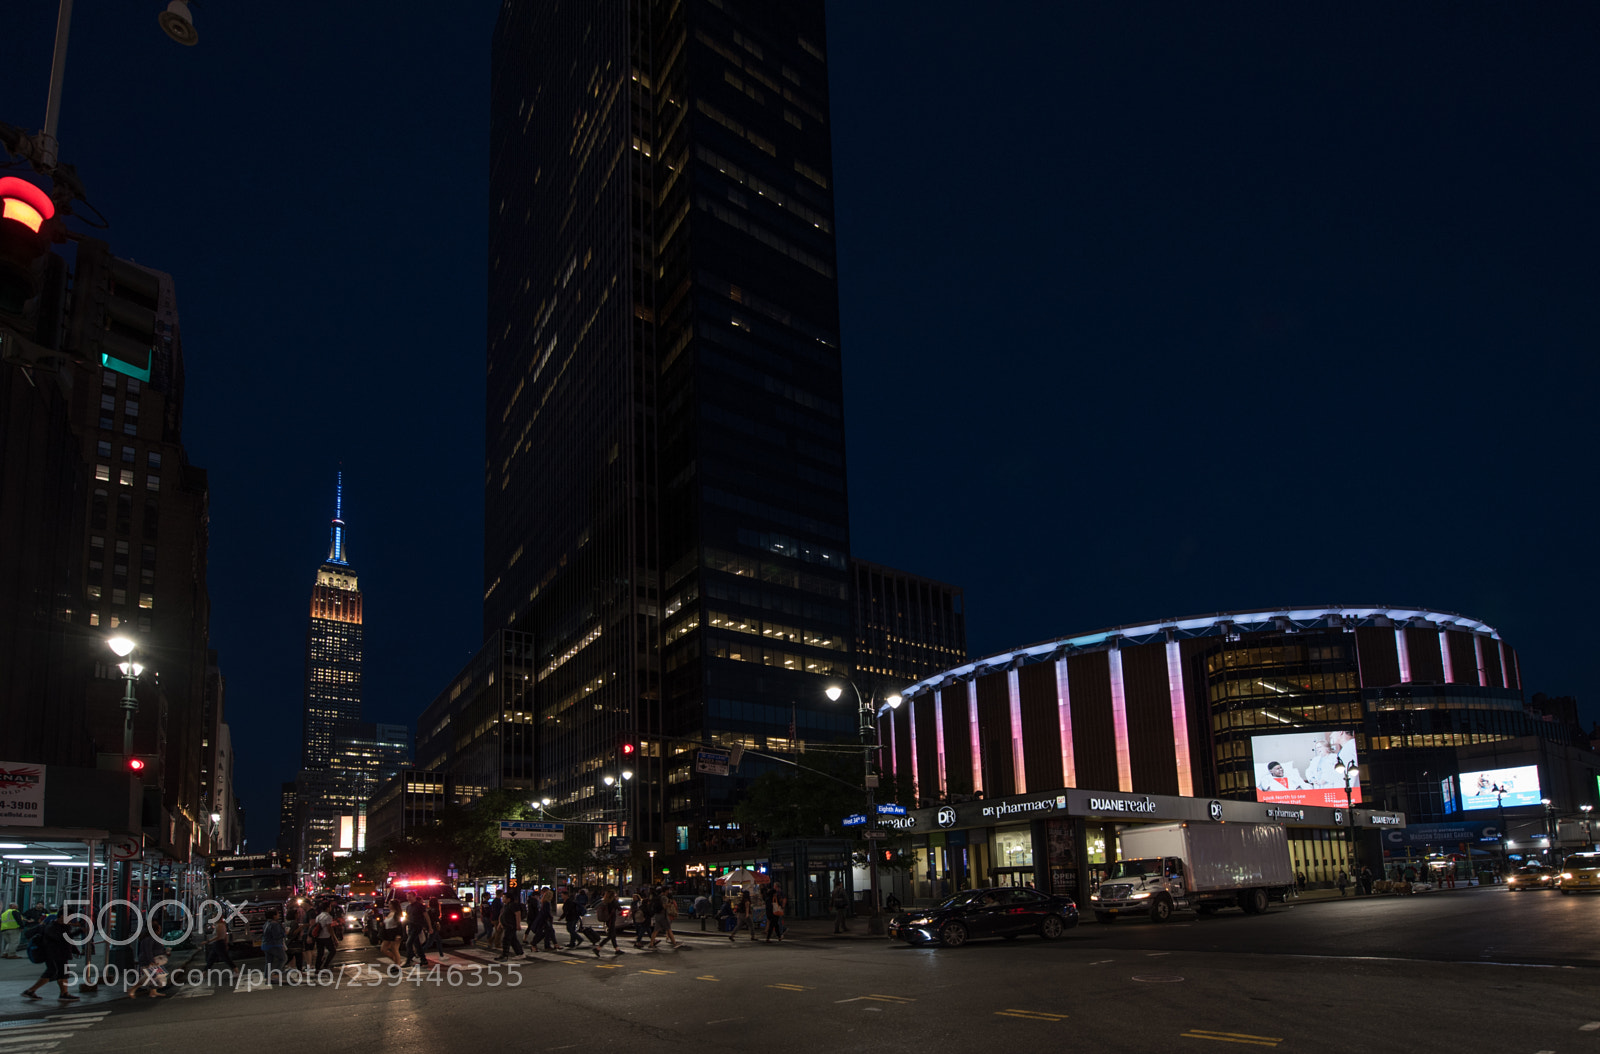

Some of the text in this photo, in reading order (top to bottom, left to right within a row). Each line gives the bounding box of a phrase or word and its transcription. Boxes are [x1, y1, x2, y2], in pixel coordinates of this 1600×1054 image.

[878, 805, 894, 814] Eighth
[983, 807, 995, 816] DR
[996, 799, 1056, 818] pharmacy
[1275, 807, 1300, 821] pharmacy
[843, 818, 853, 826] West
[861, 815, 866, 823] St
[938, 809, 955, 825] DR
[217, 854, 266, 862] LOADMASTER
